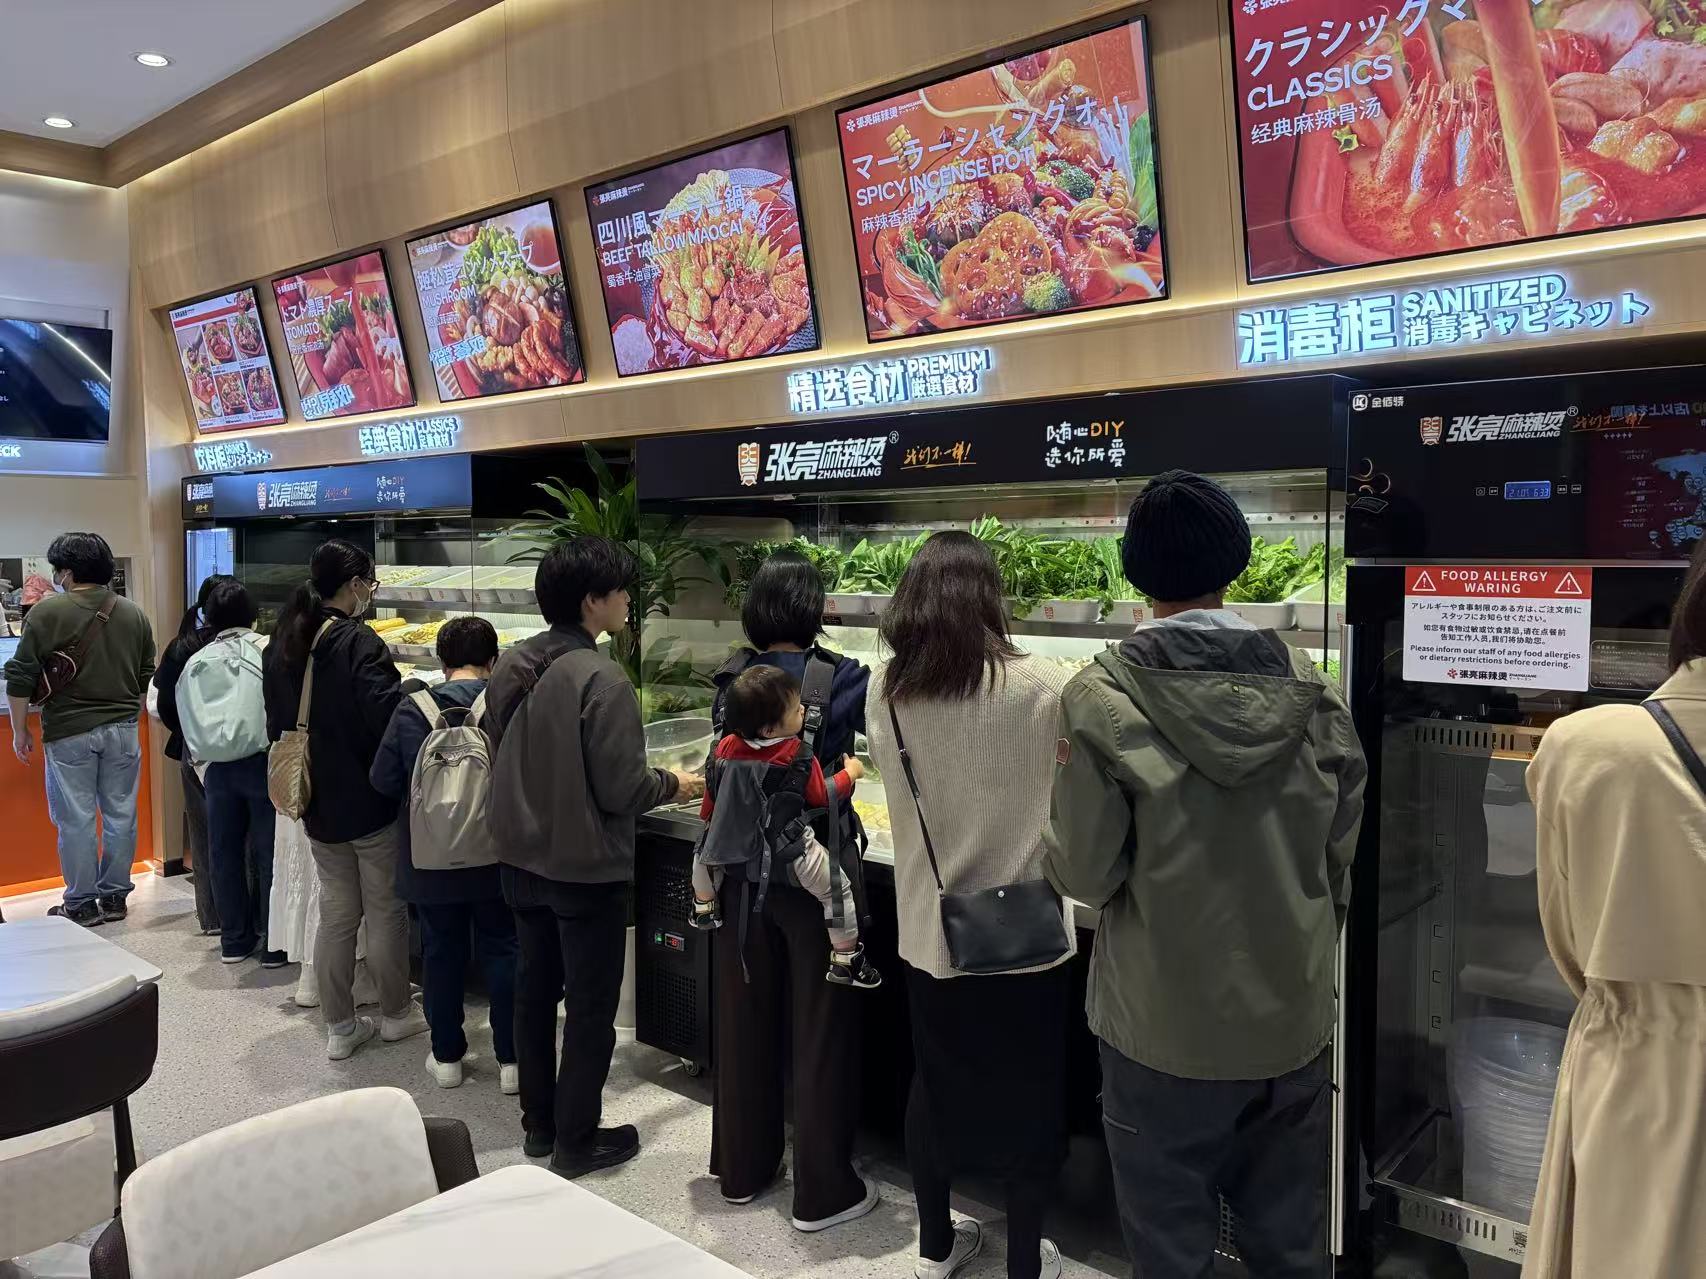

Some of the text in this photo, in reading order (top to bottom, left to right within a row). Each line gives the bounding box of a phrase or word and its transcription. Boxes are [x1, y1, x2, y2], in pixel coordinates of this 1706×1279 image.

[1247, 55, 1393, 111] CLASSICS
[1250, 97, 1382, 146] 经典麻辣骨汤
[856, 146, 1034, 206] SPICY INCENSE POT
[603, 219, 744, 267] BEEF TALLOW MAOCAI
[422, 285, 477, 309] MUSHROOM
[1402, 274, 1567, 318] SANITIZED
[287, 321, 320, 340] TOMATO
[1238, 293, 1396, 363] 消毒柜
[1402, 293, 1650, 347] 消毒キャビネット
[908, 349, 989, 377] PREMIUM
[787, 361, 908, 412] 精选食材
[1371, 396, 1404, 408] 金佰特
[1499, 430, 1560, 441] ZHANGLIANG
[1044, 438, 1126, 469] 选你所爱
[817, 466, 882, 479] ZHANGLIANG
[1440, 570, 1548, 583] FOOD ALLERGY
[1464, 582, 1521, 594] WARING
[1411, 602, 1582, 614] アレルギーや食事制限のある方は、ご注文前に
[1441, 612, 1548, 623] スタッフにお知らせください。
[1410, 645, 1435, 653] Please
[1436, 645, 1461, 653] inform
[1478, 647, 1496, 655] staff
[1497, 648, 1506, 656] of
[1507, 650, 1522, 658] any
[1523, 650, 1543, 658] food
[1544, 651, 1581, 660] allergies
[1429, 654, 1456, 664] dietary
[1458, 656, 1503, 665] restrictions
[1504, 657, 1531, 666] before
[1532, 659, 1571, 669] ordering.
